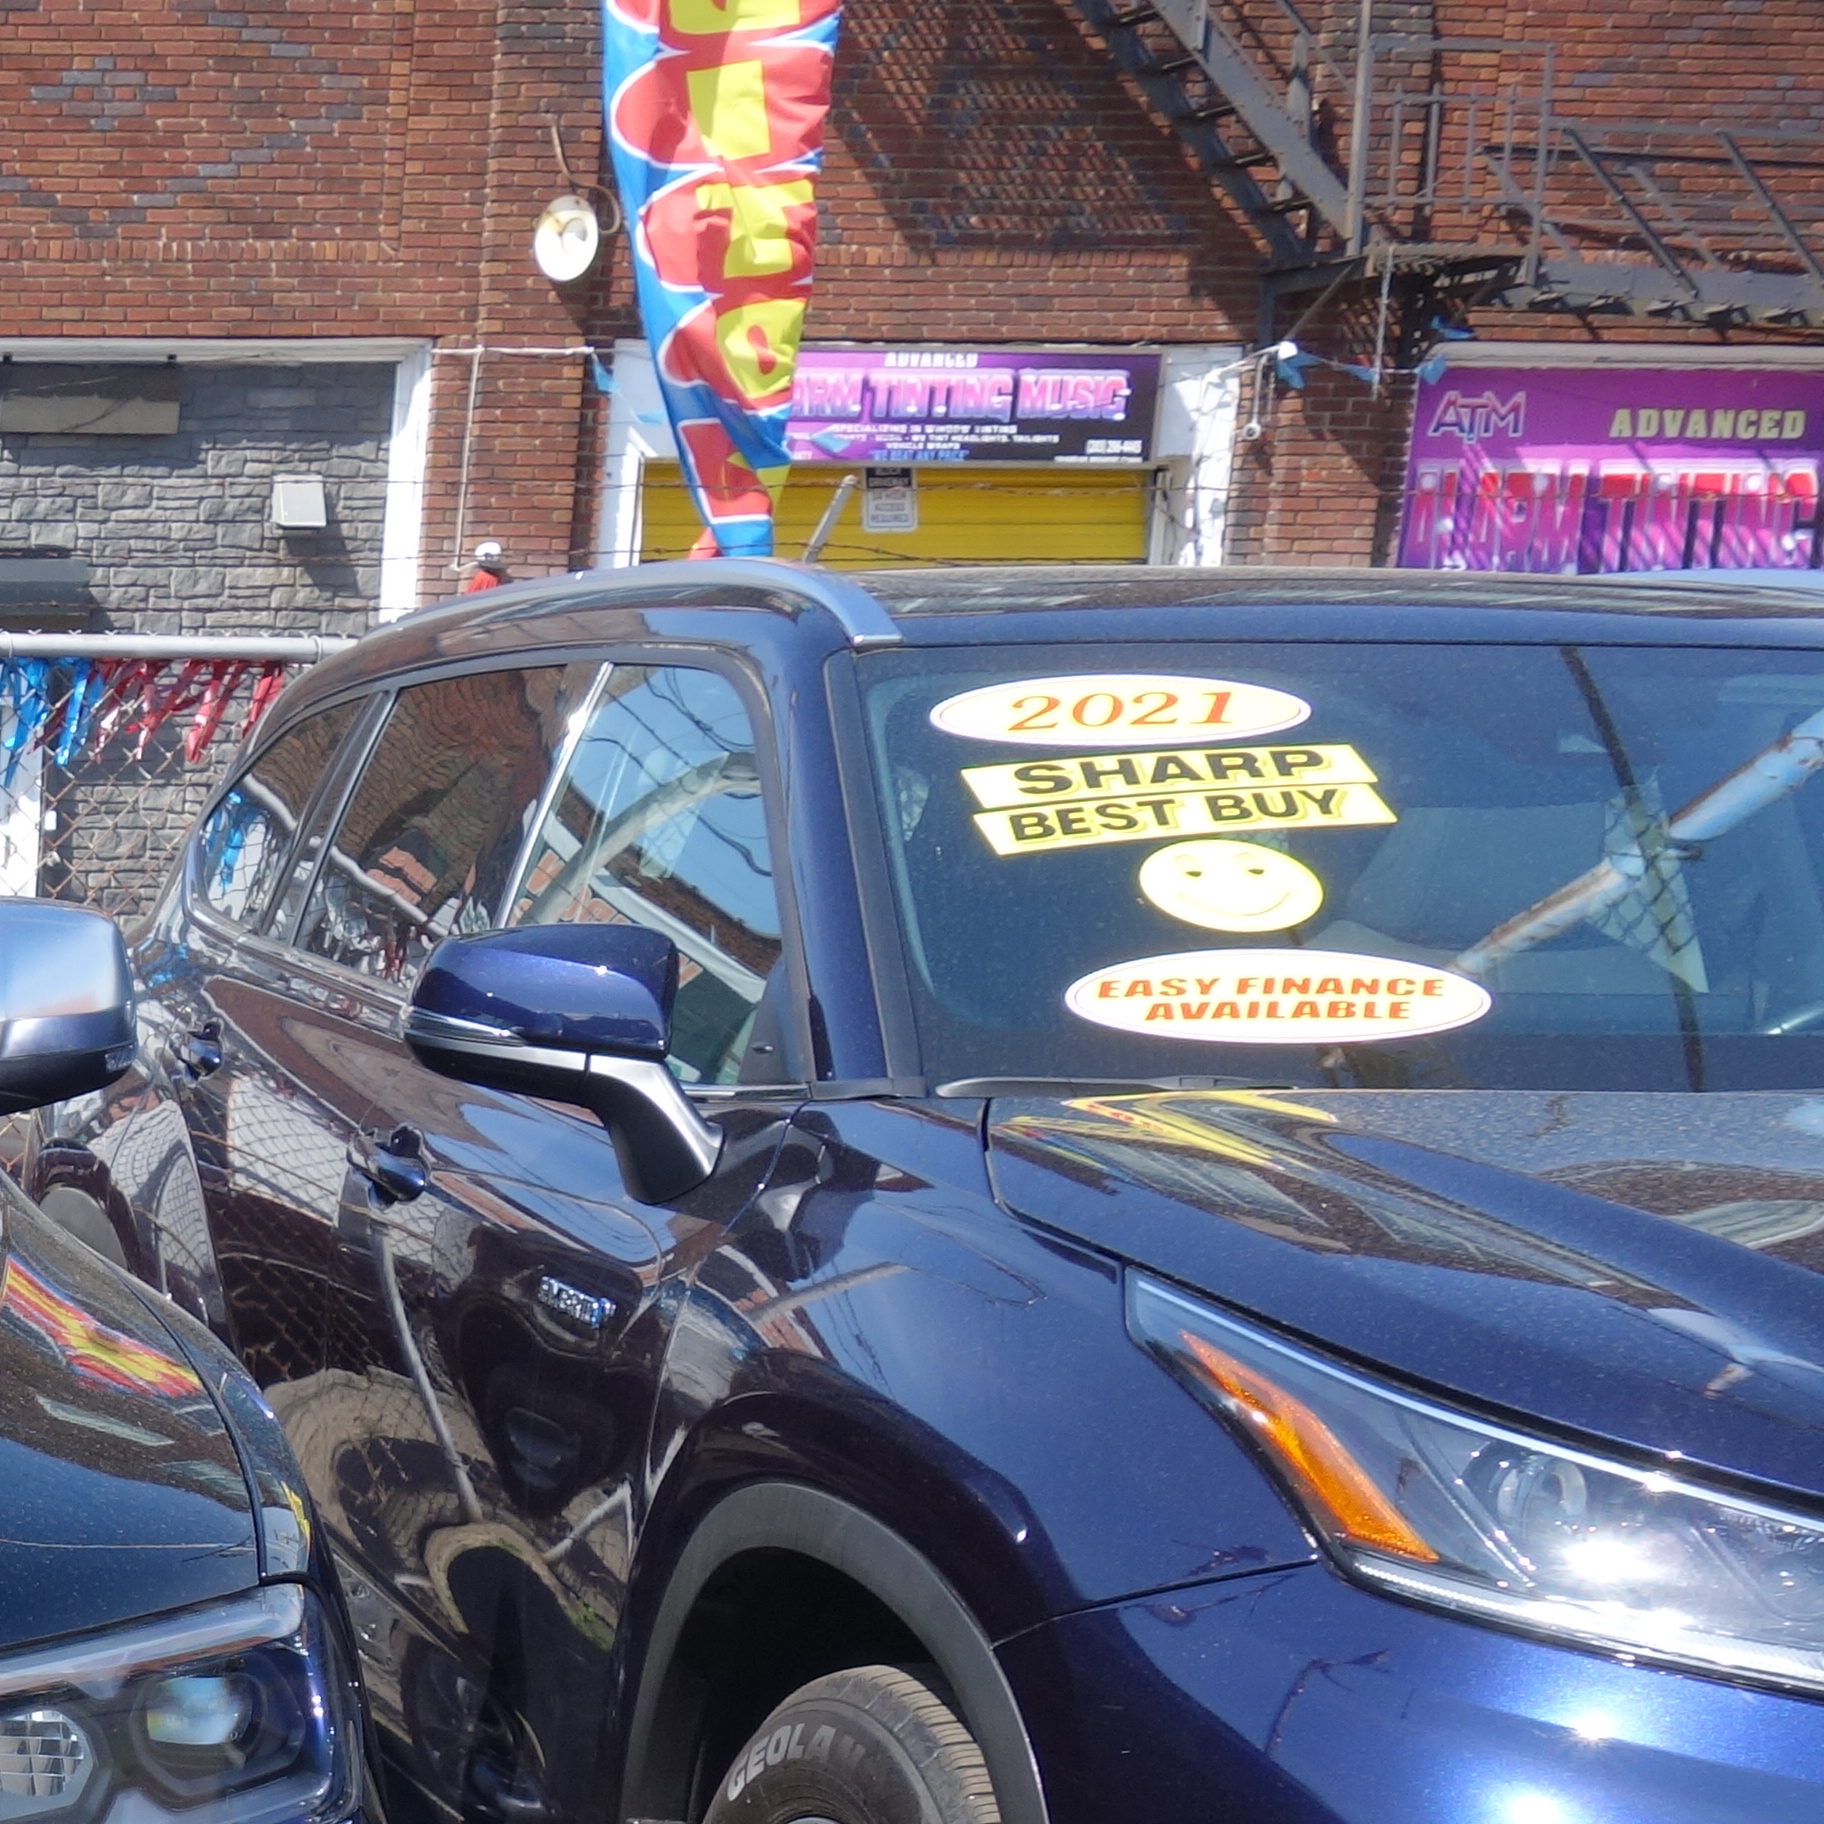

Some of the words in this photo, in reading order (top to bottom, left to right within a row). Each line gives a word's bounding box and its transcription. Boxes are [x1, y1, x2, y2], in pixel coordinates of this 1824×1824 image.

[884, 353, 978, 368] ADVANCED
[868, 369, 1016, 422] TINTING
[1017, 369, 1130, 421] MUSIC
[1428, 390, 1527, 444] ATM
[1608, 408, 1807, 440] ADVANCED
[1007, 690, 1235, 732] 2021
[1014, 750, 1325, 796] SHARP
[1008, 798, 1176, 842] BEST
[1209, 787, 1341, 824] BUY
[1098, 977, 1220, 999] EASY
[1236, 975, 1445, 998] FINANCE
[1145, 1000, 1410, 1022] AVAILABLE
